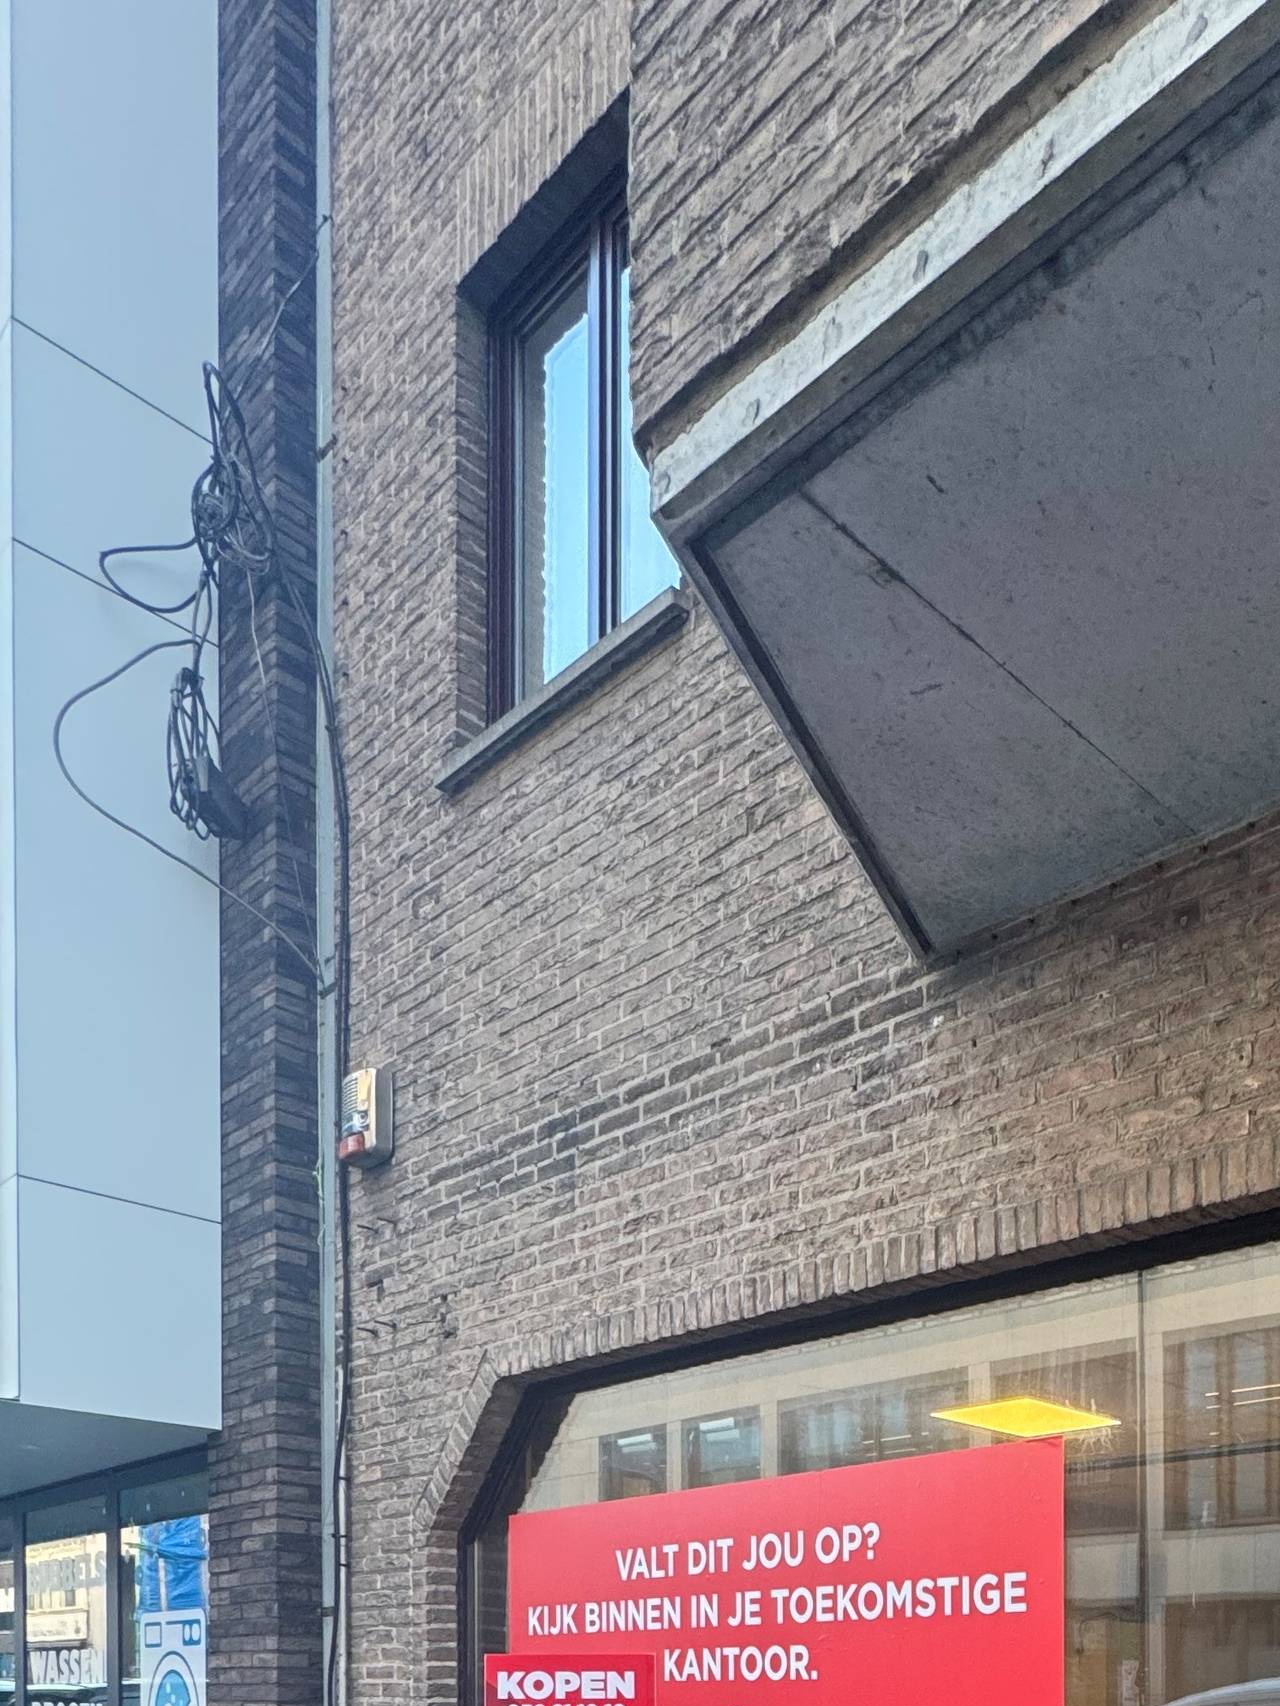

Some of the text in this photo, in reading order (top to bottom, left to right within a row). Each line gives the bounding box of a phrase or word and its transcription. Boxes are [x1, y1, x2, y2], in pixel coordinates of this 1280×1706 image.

[616, 1522, 879, 1580] VALT DIT JOU OP?
[528, 1572, 1026, 1635] KIJK BINNEN IN JE TOEKOMSTIGE
[29, 1649, 103, 1685] WASSEN
[664, 1645, 817, 1681] KANTOOR.
[498, 1671, 634, 1699] KOPEN
